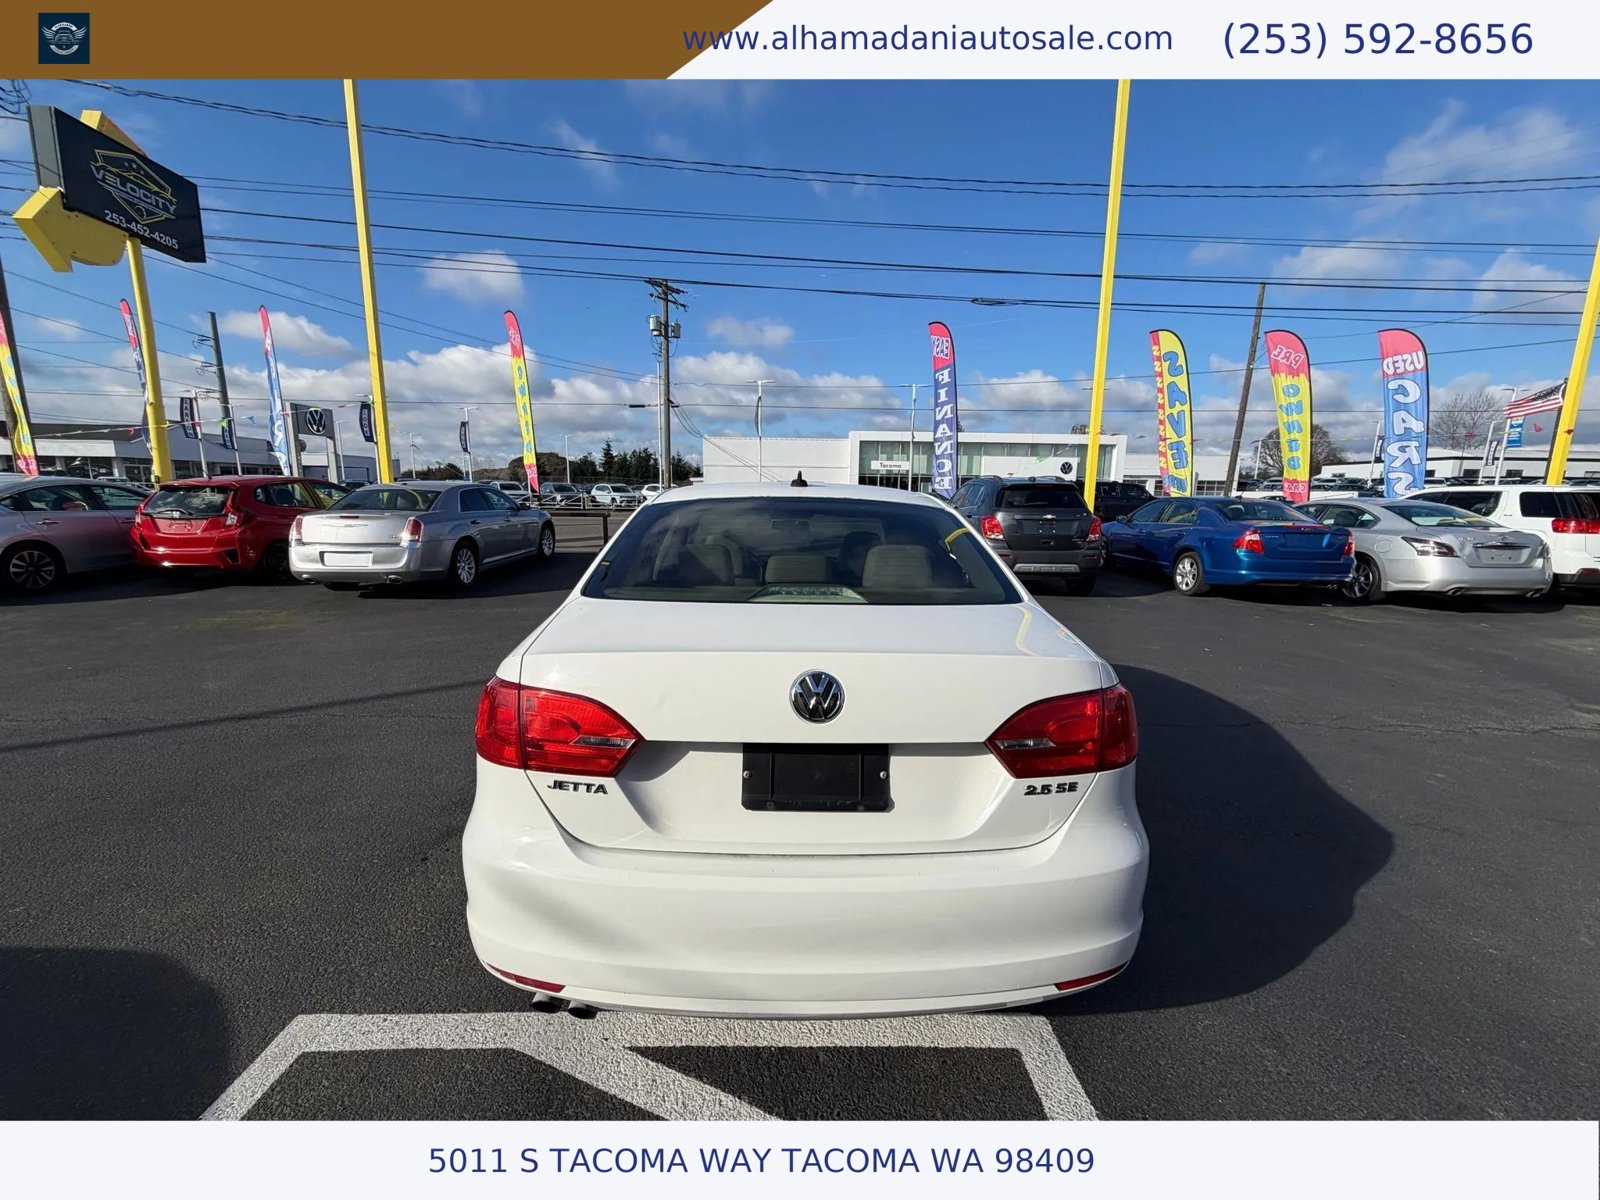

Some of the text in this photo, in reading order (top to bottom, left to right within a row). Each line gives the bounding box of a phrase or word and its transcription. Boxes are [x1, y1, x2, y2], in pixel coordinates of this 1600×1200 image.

[90, 164, 177, 214] VELOCITY
[104, 209, 179, 250] 253-452-4205
[547, 780, 609, 795] JETTA
[1024, 781, 1079, 796] 2.5 SE
